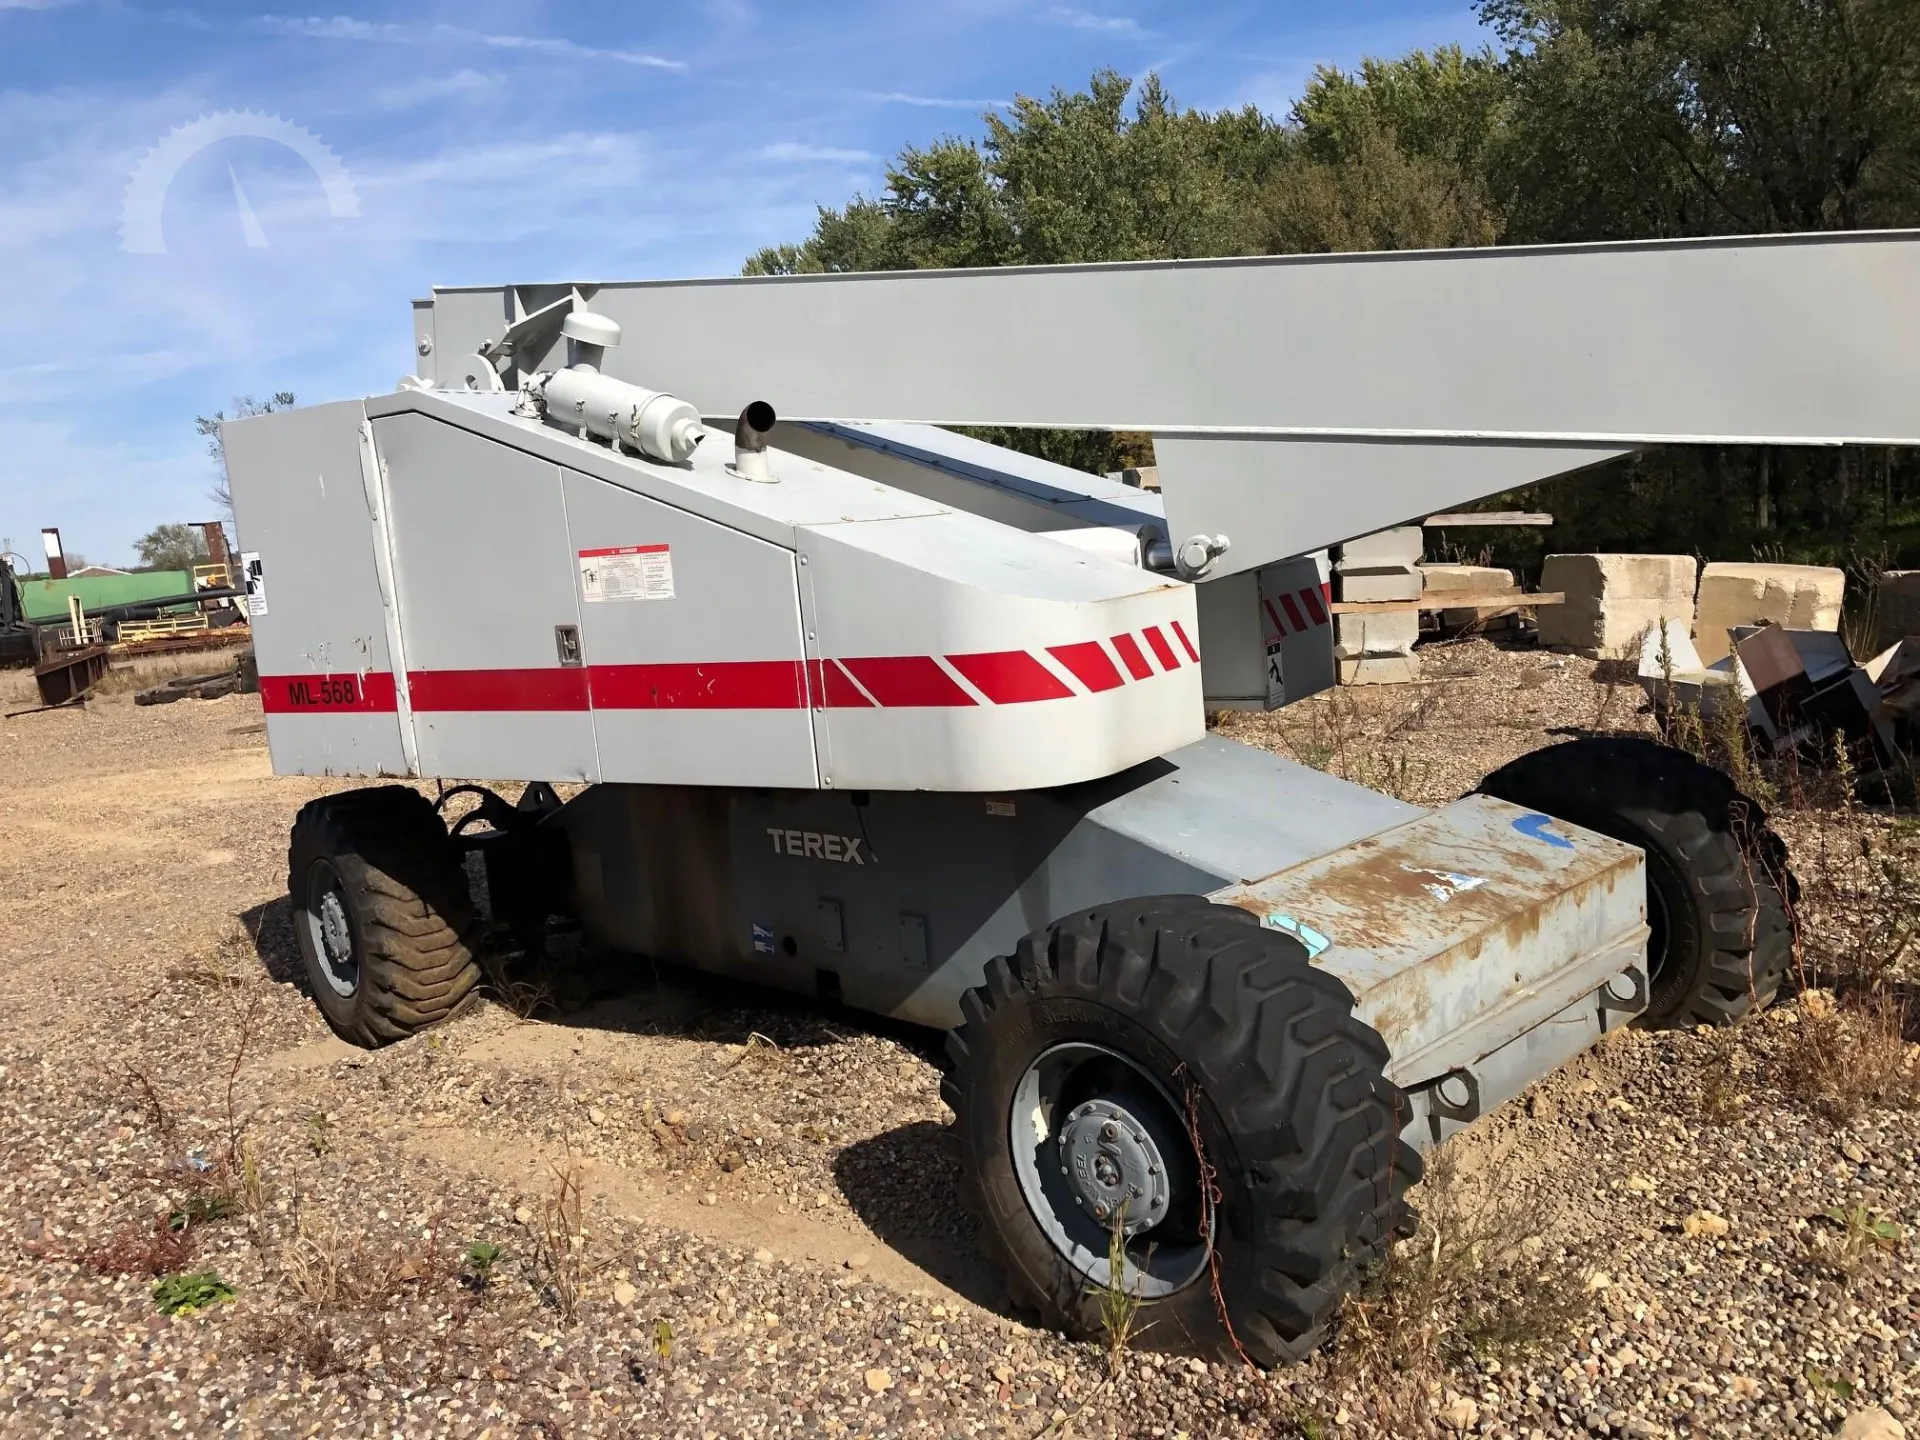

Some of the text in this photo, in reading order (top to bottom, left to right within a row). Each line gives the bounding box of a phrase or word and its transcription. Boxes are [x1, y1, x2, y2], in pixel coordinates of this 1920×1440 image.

[287, 680, 355, 705] ML 568
[766, 827, 865, 865] TEREX
